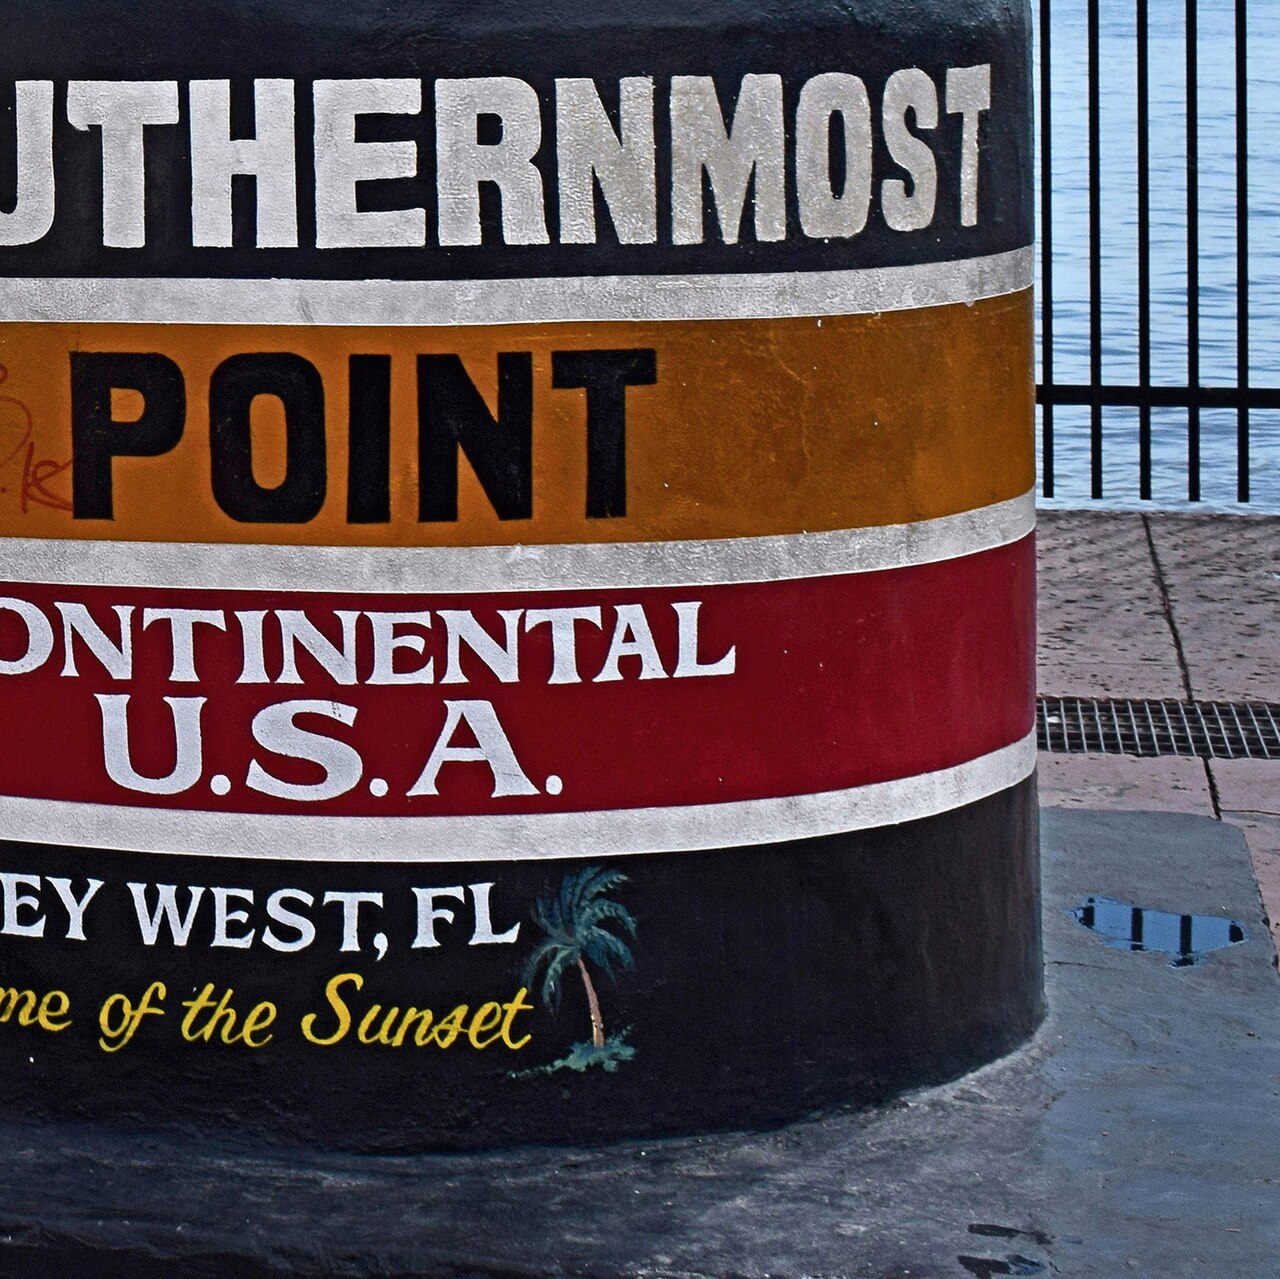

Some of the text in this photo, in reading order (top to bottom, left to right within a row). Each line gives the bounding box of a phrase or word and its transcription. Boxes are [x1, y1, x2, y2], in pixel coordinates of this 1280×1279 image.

[69, 347, 658, 525] POINT
[93, 693, 563, 802] U.S.A.
[126, 882, 389, 961] WEST,
[410, 882, 521, 949] FL
[98, 982, 167, 1053] of
[182, 987, 277, 1048] the
[301, 973, 534, 1050] Sunset
